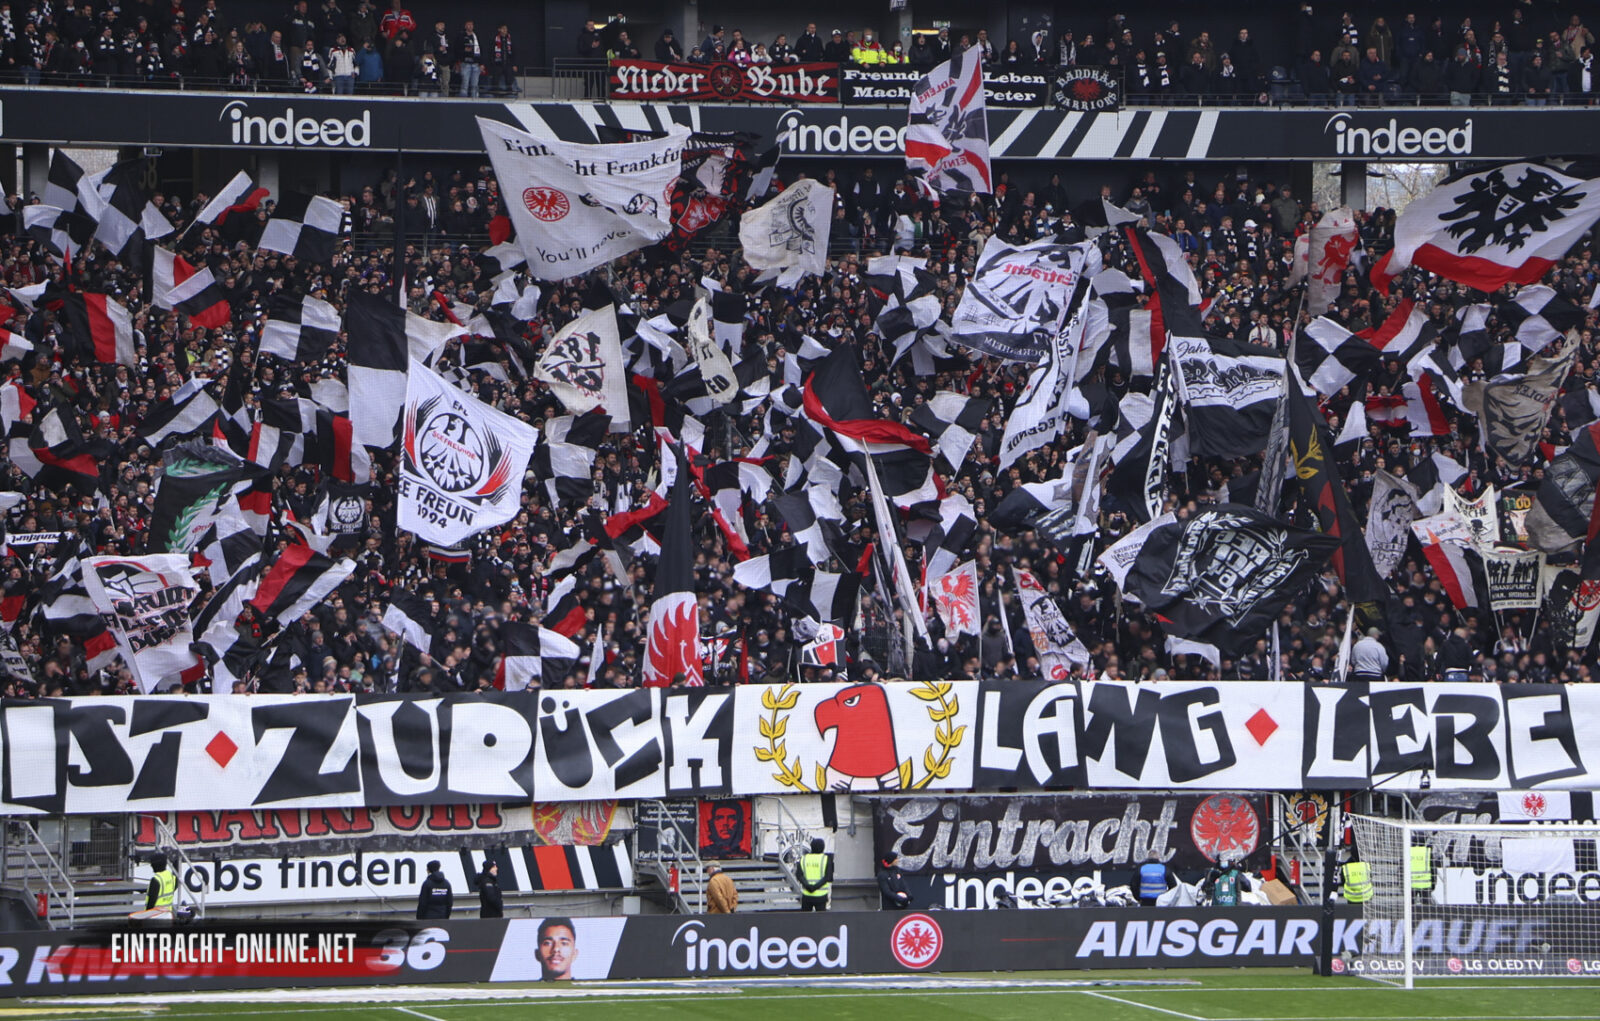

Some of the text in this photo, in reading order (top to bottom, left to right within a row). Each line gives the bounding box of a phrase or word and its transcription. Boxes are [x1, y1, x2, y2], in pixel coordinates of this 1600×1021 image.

[615, 64, 831, 97] Nieder Bube
[853, 86, 1037, 102] Mach Peter
[983, 71, 1047, 85] Leben
[1054, 90, 1119, 112] WARRIORS
[229, 106, 371, 148] indeed
[787, 115, 908, 152] indee
[1335, 117, 1473, 155] indeed
[503, 138, 686, 176] Eintht Frankfu
[592, 230, 632, 254] neve
[416, 503, 448, 529] 1994
[10, 693, 723, 806] IST ZURÜCK
[981, 684, 1579, 785] LANG LEBE
[887, 797, 1177, 872] Eintracht
[183, 852, 263, 893] obs
[943, 870, 1102, 910] indeed
[684, 924, 848, 972] indeed
[1075, 918, 1547, 958] ANSGAR KNAUFF
[1462, 959, 1544, 971] LG OLED TV
